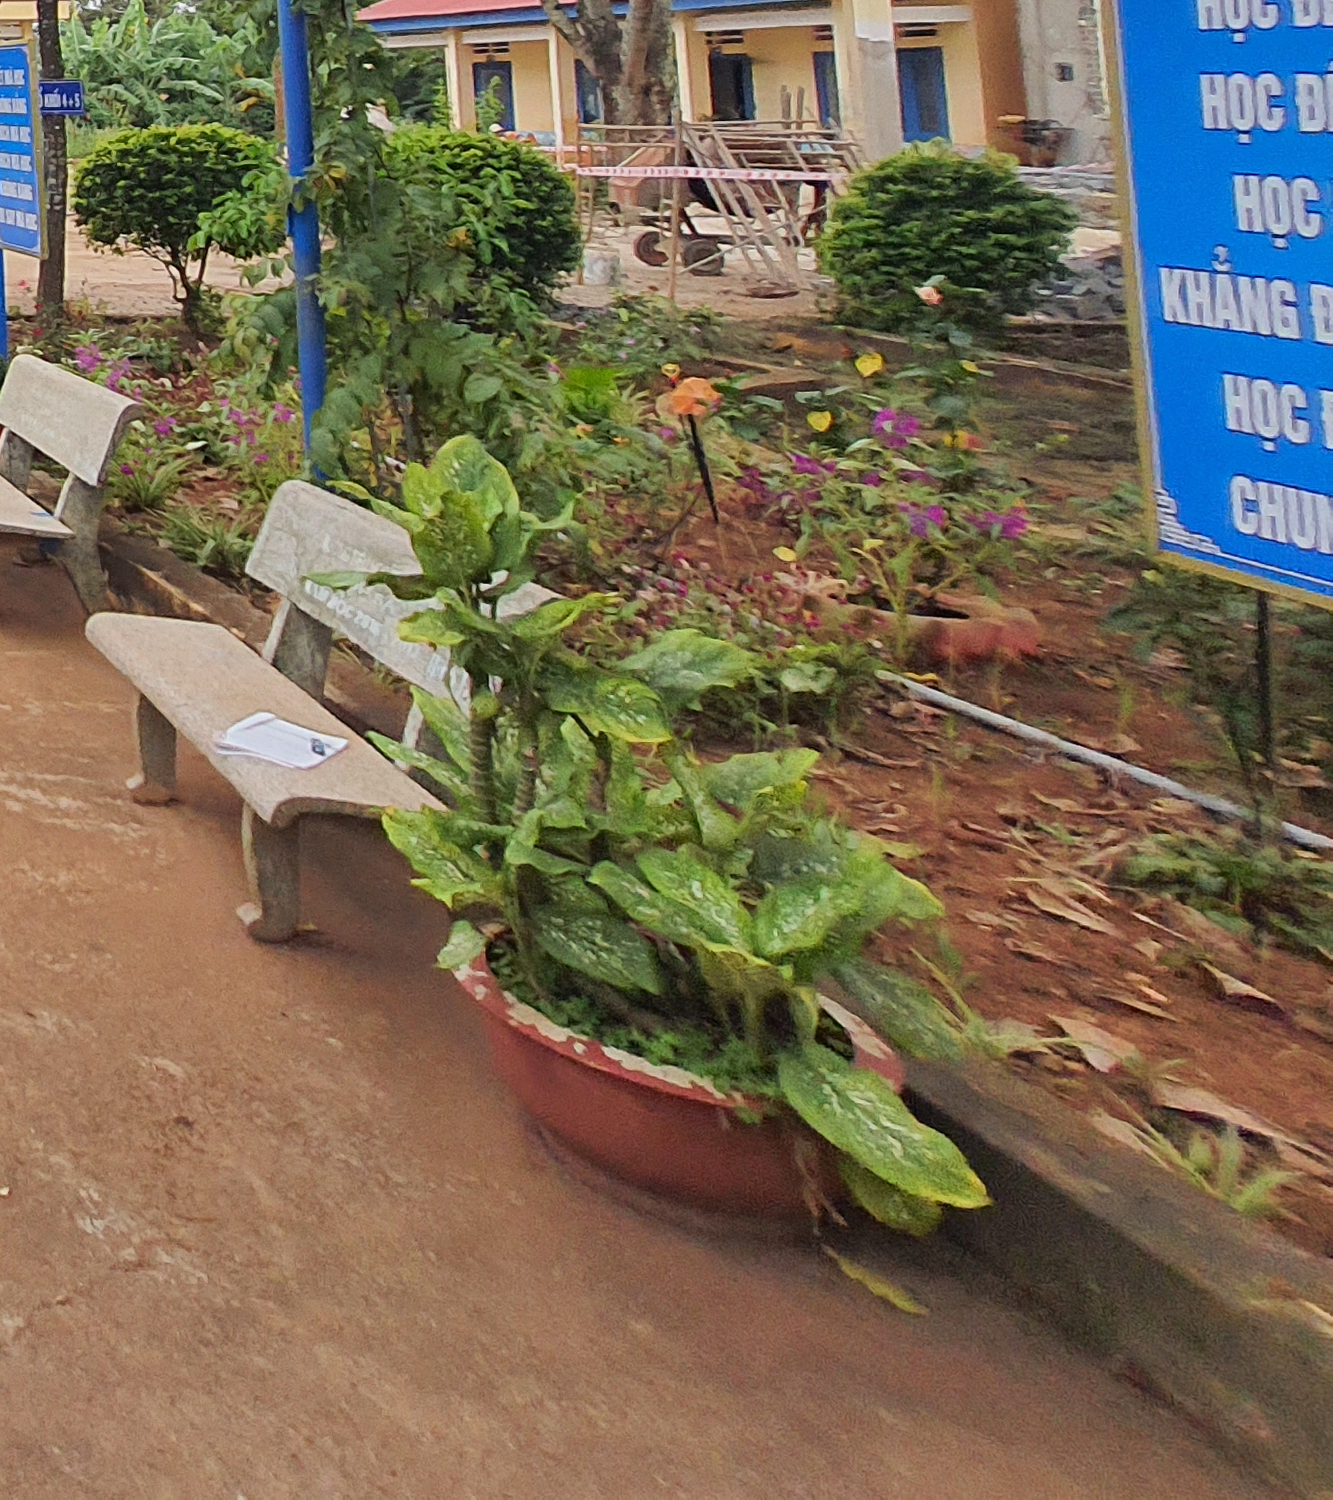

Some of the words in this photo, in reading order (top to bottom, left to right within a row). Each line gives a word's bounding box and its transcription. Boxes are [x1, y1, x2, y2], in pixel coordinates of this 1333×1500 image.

[1199, 71, 1285, 144] HỌC
[1233, 173, 1322, 249] HỌC
[1159, 244, 1302, 340] KHẲNG
[1223, 372, 1311, 452] HỌC
